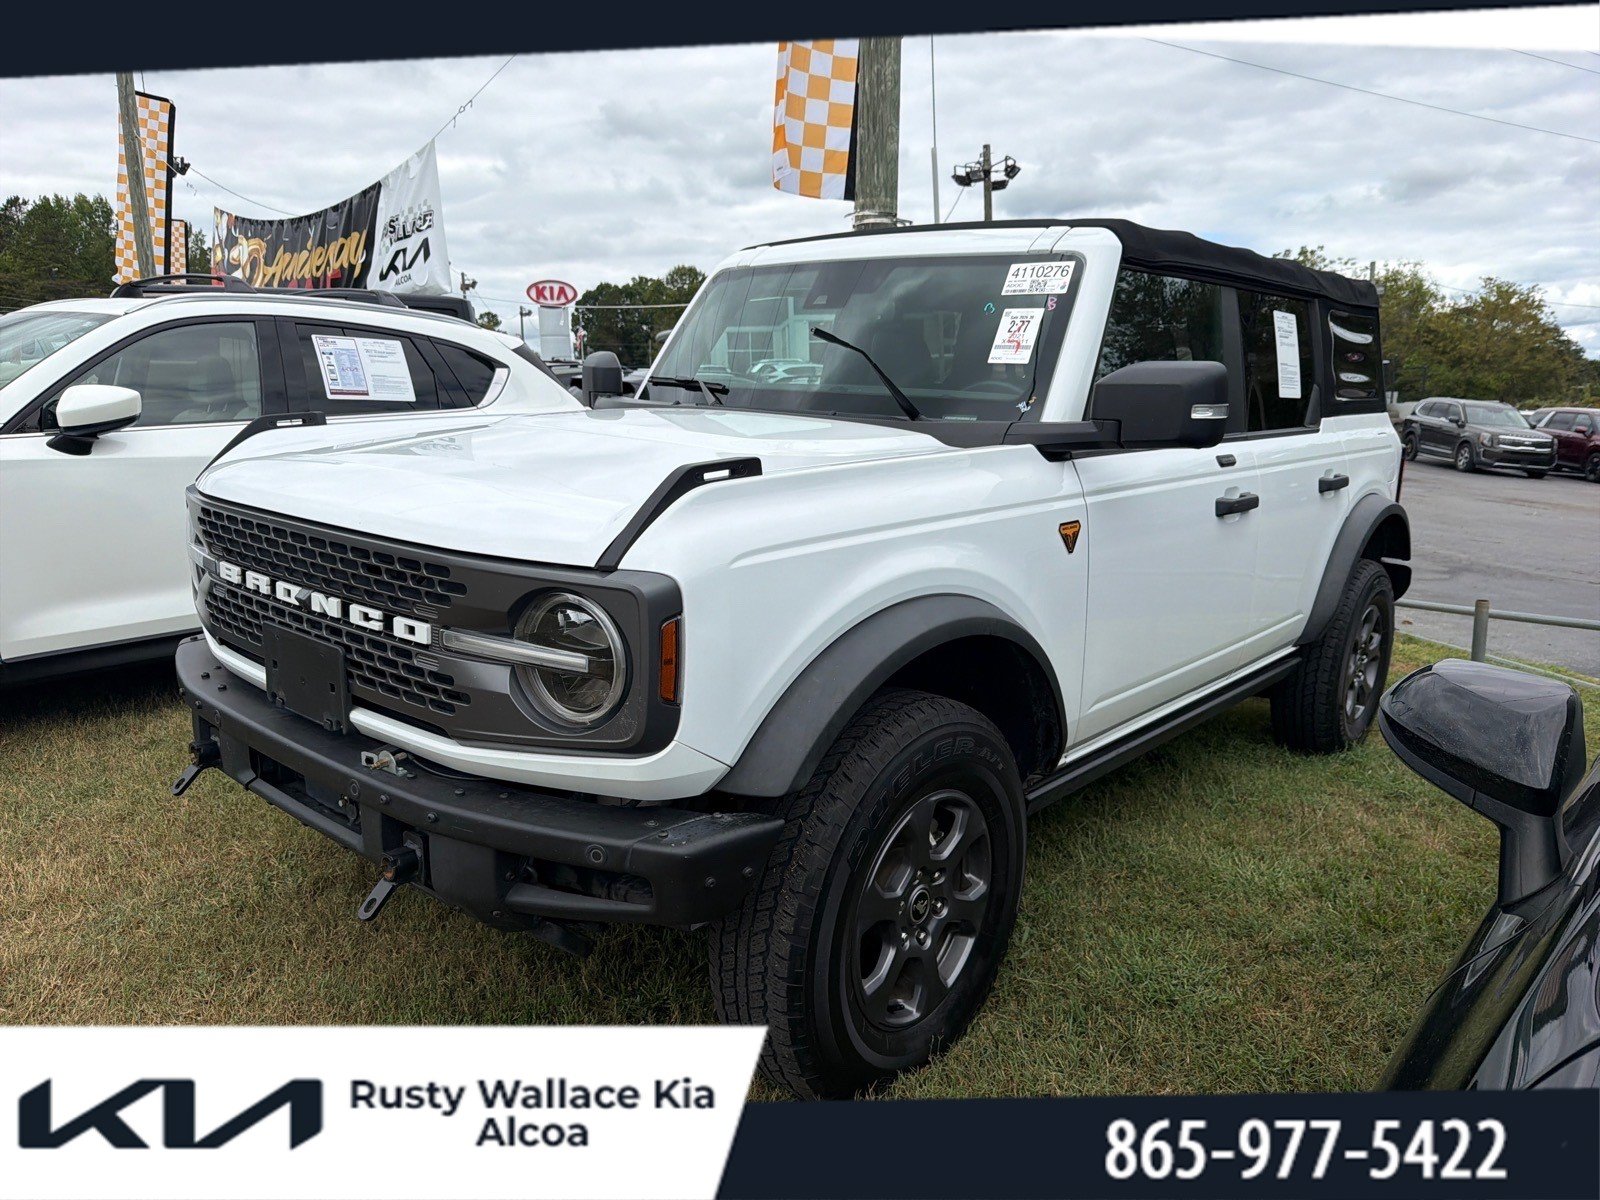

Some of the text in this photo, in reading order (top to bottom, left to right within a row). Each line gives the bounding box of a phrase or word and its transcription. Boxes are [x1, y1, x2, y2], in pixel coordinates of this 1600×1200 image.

[379, 236, 431, 282] KIA
[1011, 264, 1071, 279] 4110276
[534, 285, 570, 302] KIA
[219, 561, 432, 646] BRONCO
